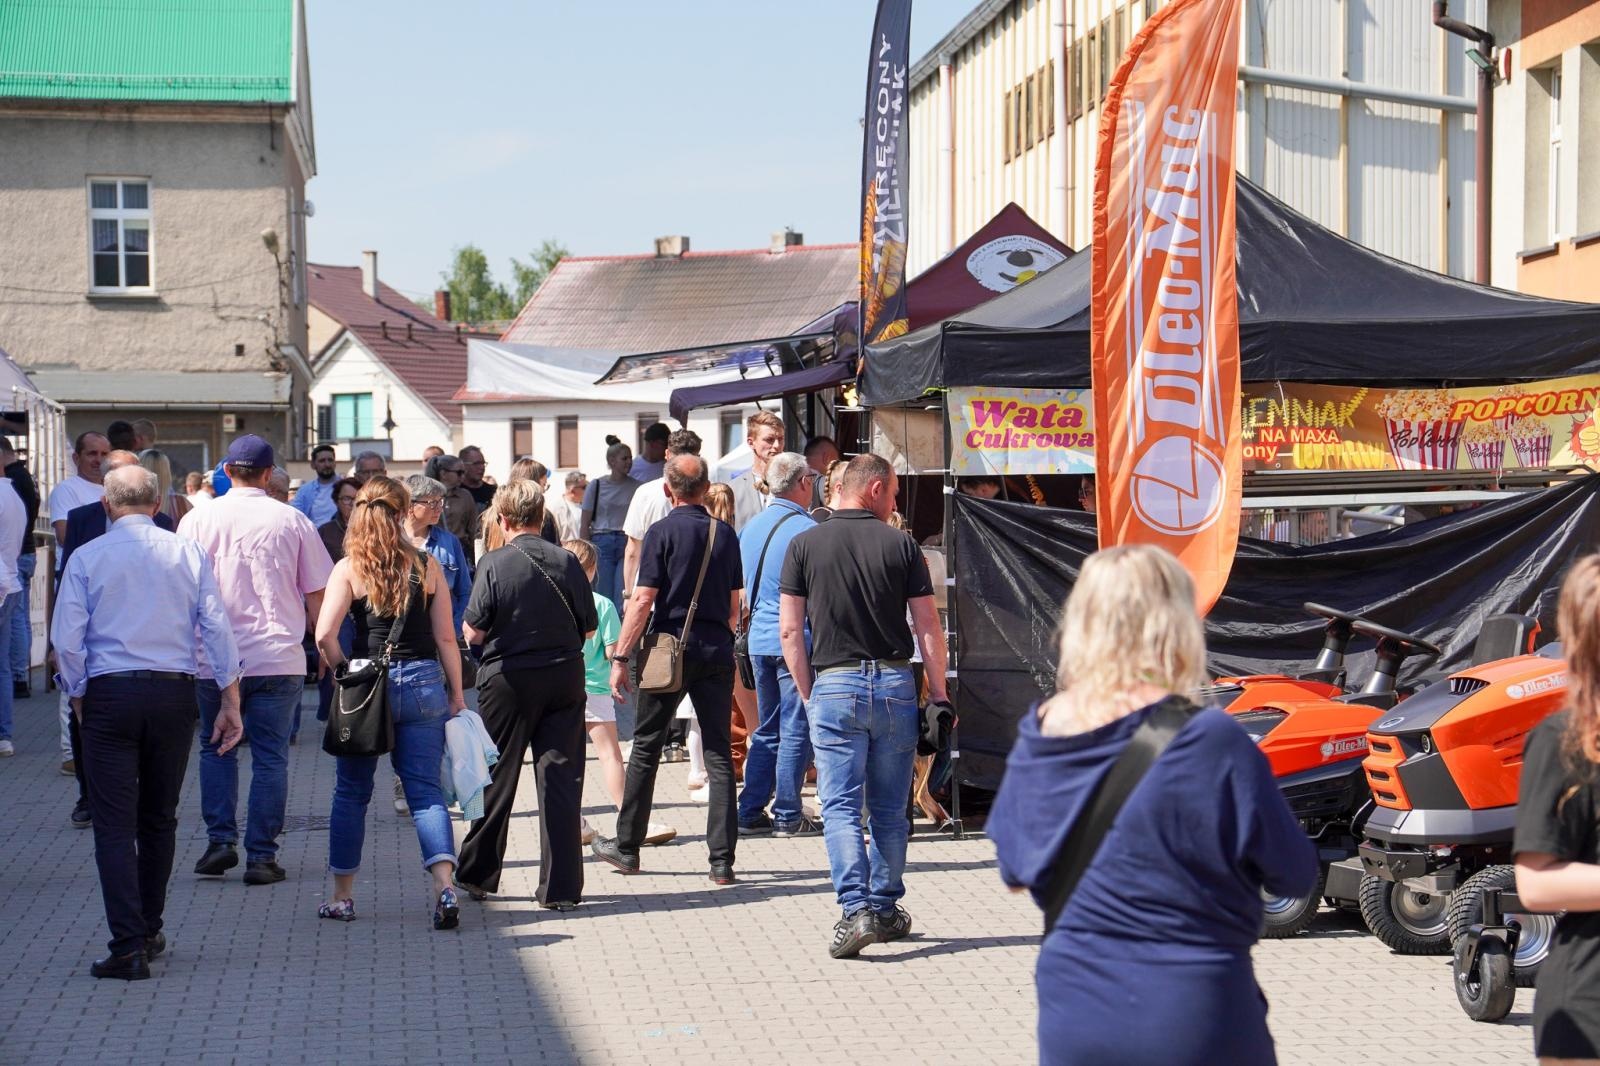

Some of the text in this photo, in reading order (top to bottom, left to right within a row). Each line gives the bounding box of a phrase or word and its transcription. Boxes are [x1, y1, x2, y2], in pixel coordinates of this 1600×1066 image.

[1144, 103, 1203, 431] Oleo-Mac
[971, 400, 1083, 429] Wata
[1241, 388, 1368, 429] IEMNIAK
[1451, 389, 1600, 421] POPCORN
[965, 428, 1095, 449] Cukrowa
[1260, 429, 1339, 443] NA MAXA
[1242, 445, 1277, 462] ony
[1522, 674, 1568, 697] Oleo-M
[1335, 736, 1369, 753] Oleo-M
